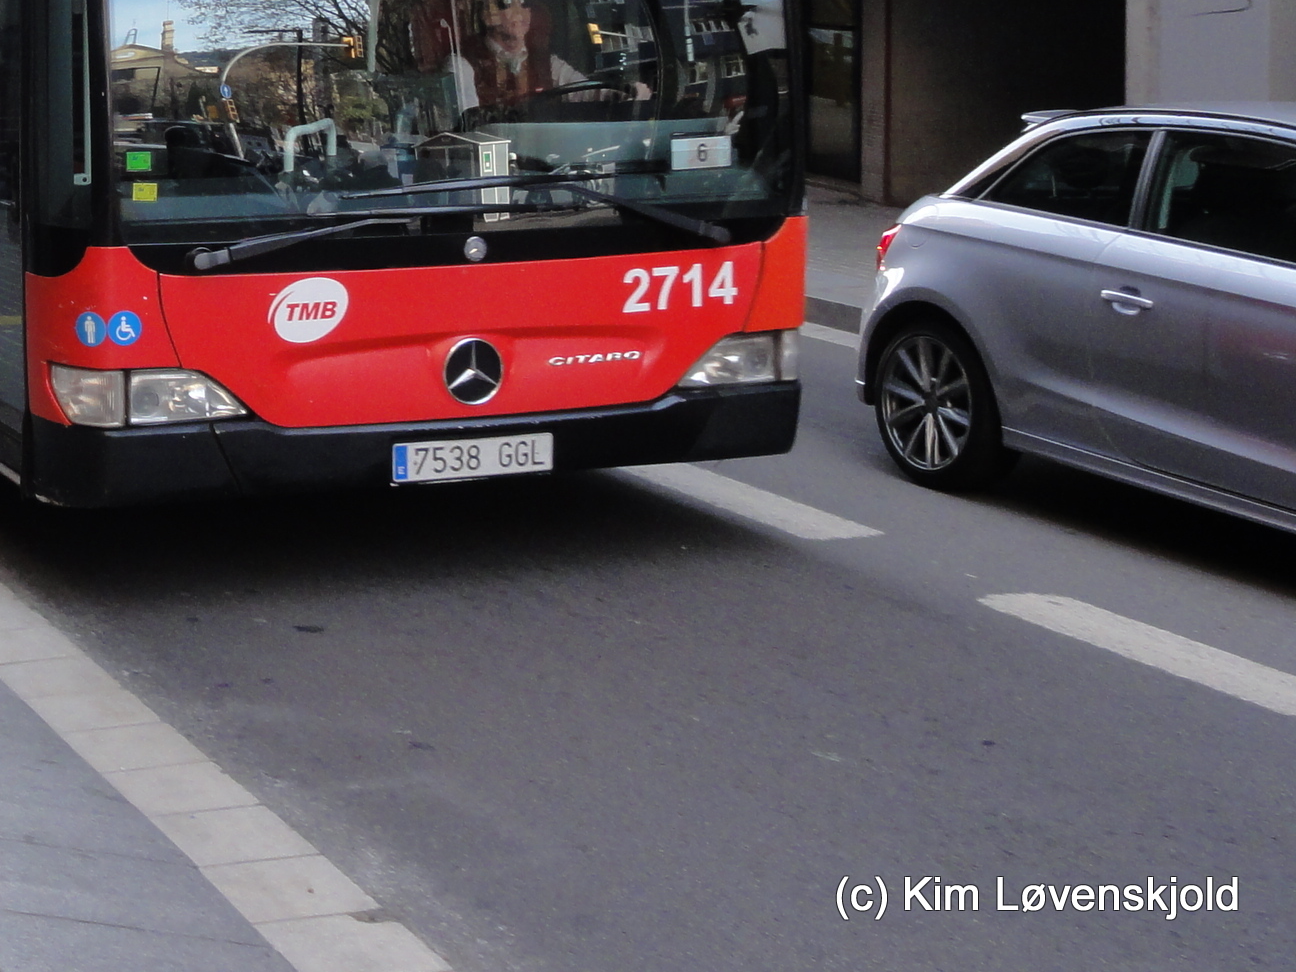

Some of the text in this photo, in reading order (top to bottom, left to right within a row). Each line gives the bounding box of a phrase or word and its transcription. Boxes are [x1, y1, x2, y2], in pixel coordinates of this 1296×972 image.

[697, 142, 708, 163] 6
[622, 260, 739, 314] 2714
[285, 300, 338, 322] TMB
[548, 350, 642, 367] CITARO
[414, 444, 482, 475] 7538
[497, 439, 545, 468] GGL
